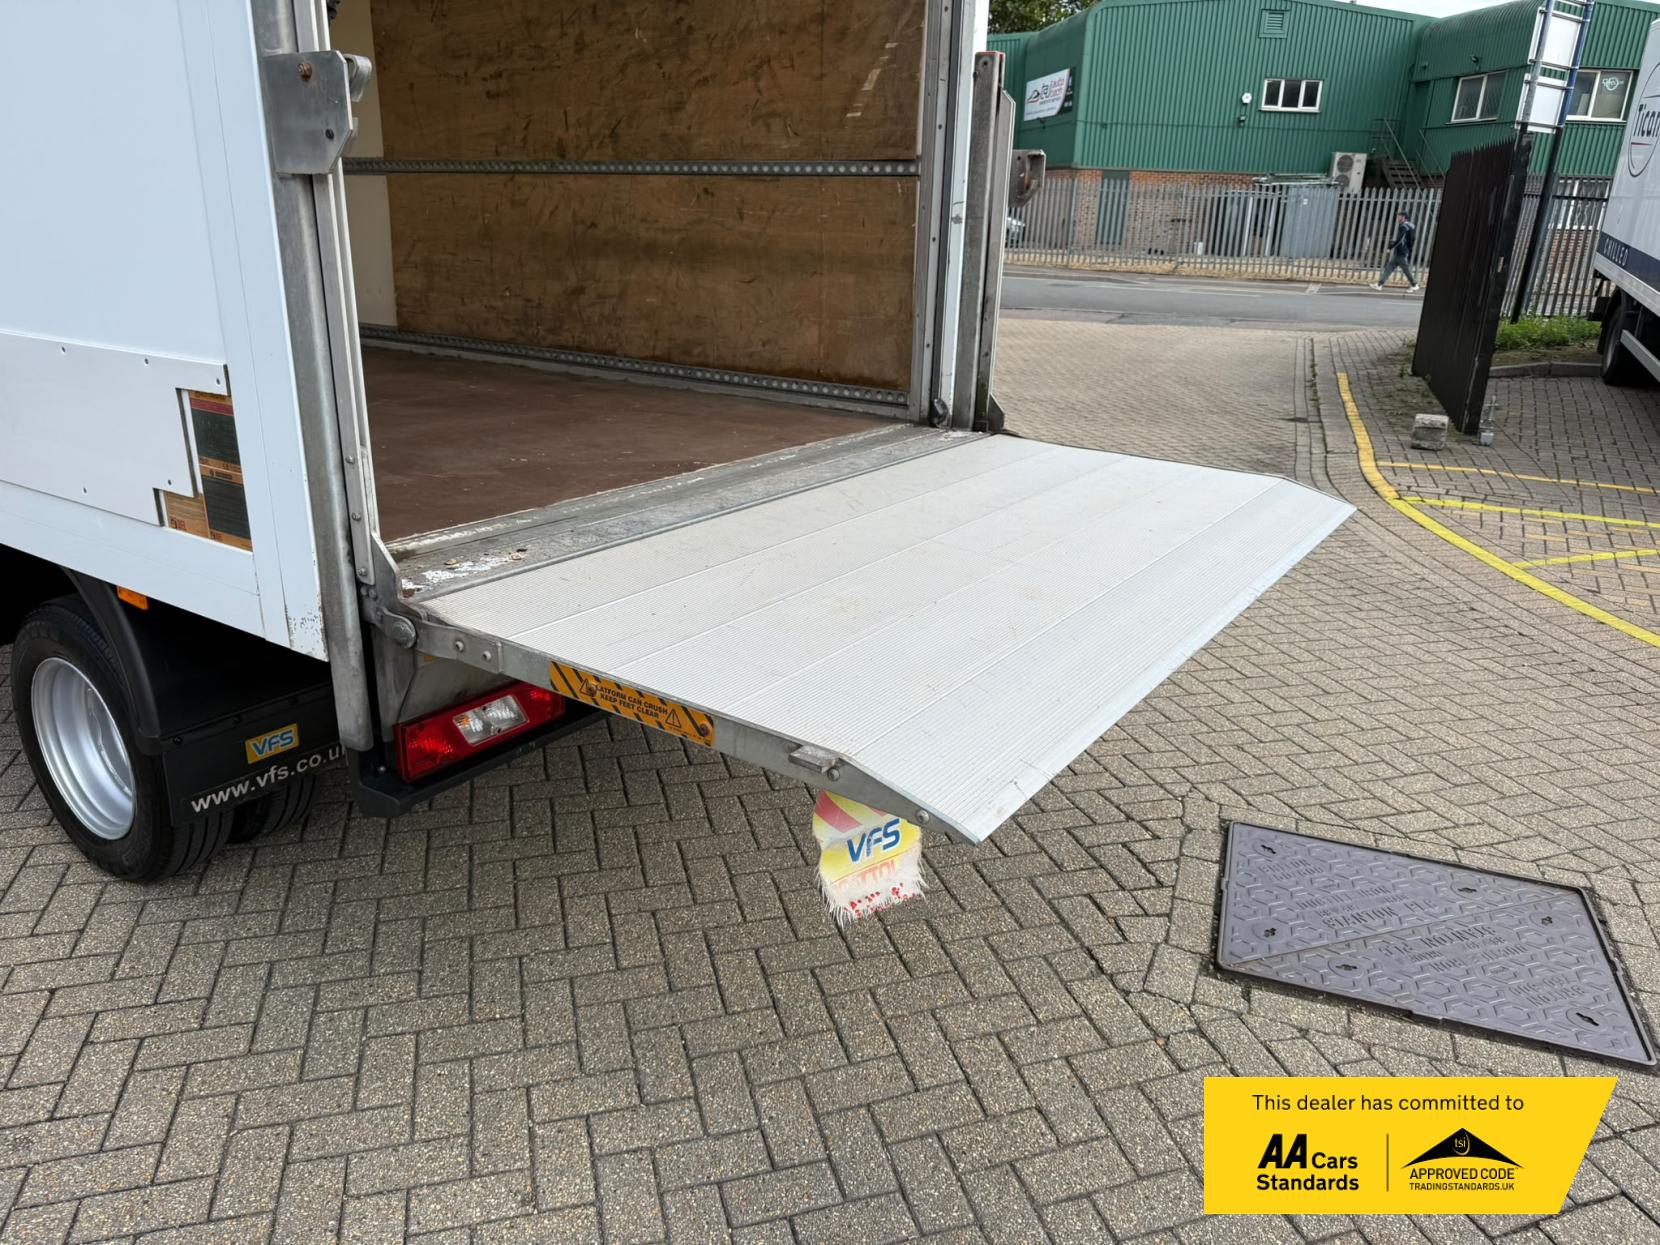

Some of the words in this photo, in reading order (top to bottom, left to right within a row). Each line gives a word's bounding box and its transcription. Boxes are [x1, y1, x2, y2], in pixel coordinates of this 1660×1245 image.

[1603, 237, 1628, 267] CHILLED
[600, 693, 618, 704] KEEP
[619, 699, 636, 711] FEET
[636, 705, 660, 720] CLEAR
[627, 695, 643, 708] CAN
[643, 701, 669, 715] CRUSH
[253, 730, 295, 756] VFS
[846, 818, 901, 863] VFS
